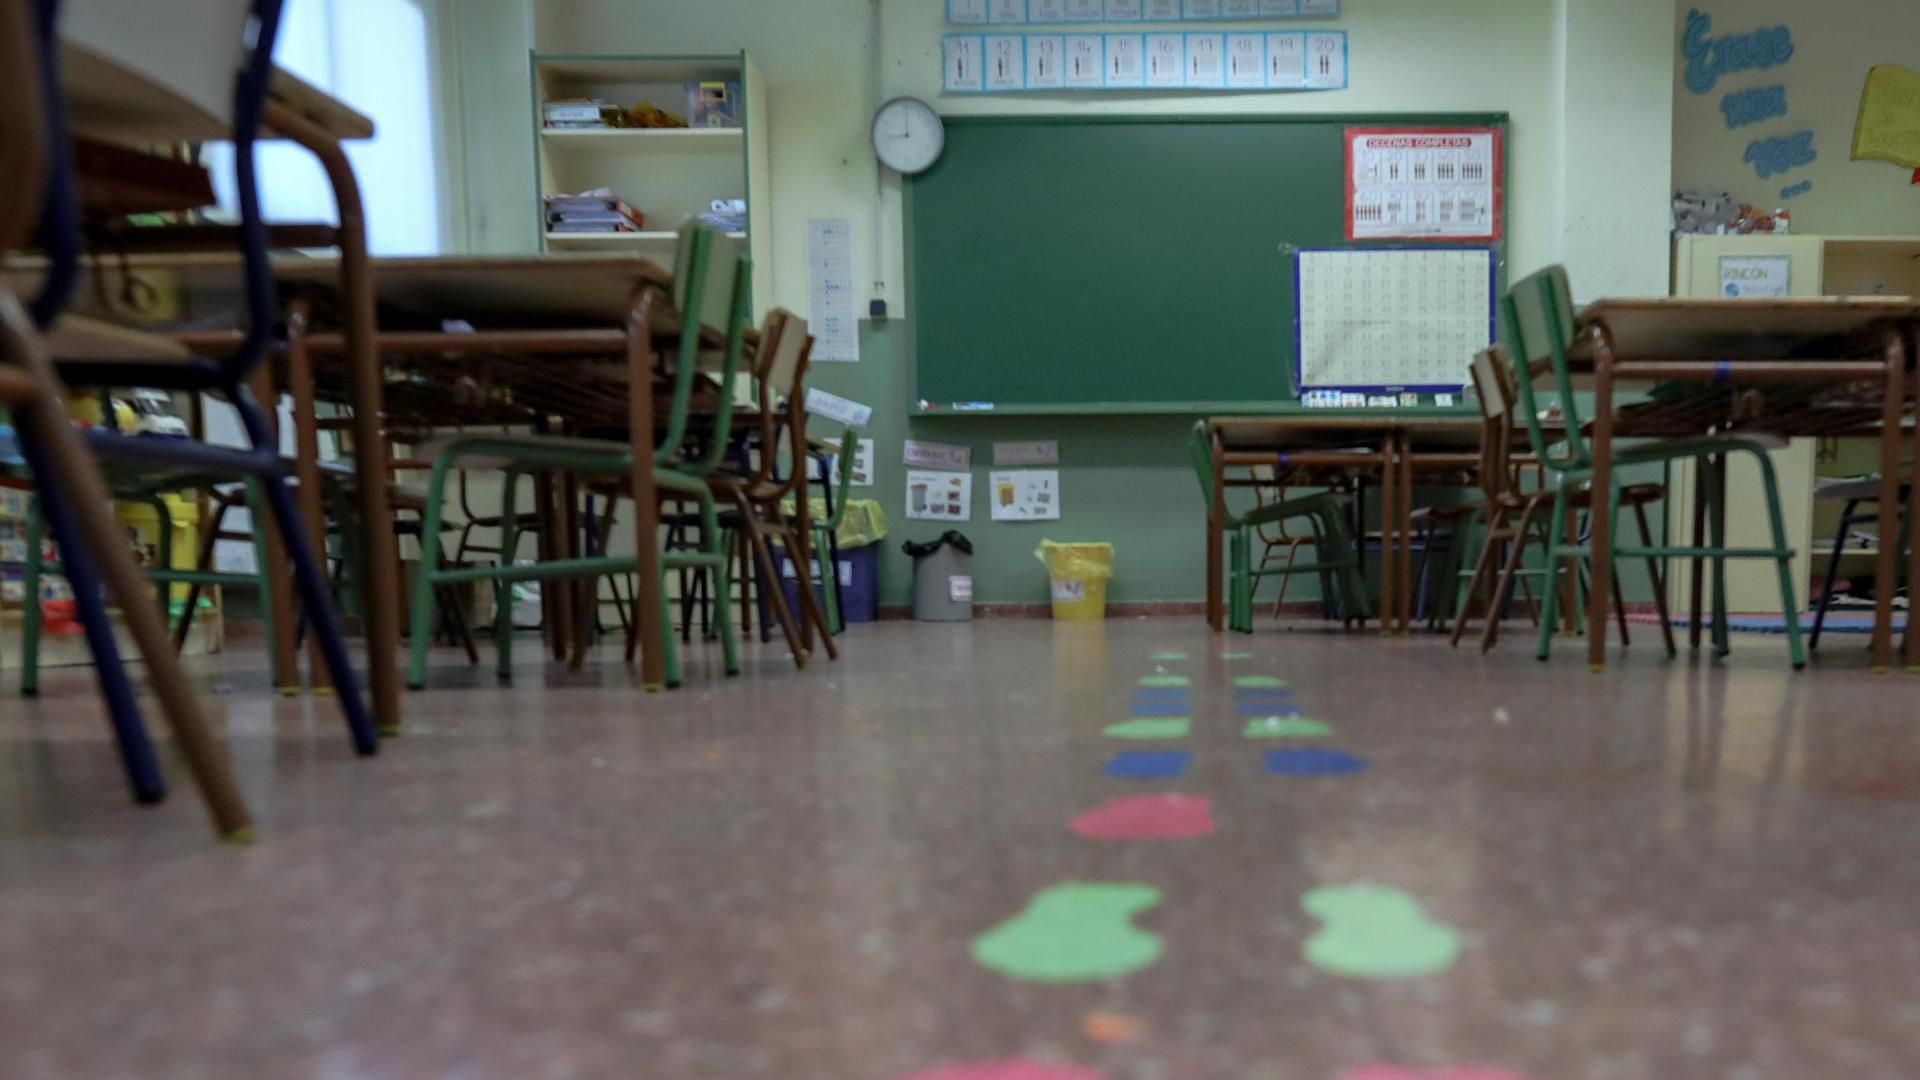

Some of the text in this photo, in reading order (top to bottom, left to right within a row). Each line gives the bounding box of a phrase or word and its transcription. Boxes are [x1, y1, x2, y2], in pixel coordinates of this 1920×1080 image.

[957, 40, 970, 56] 11
[996, 39, 1012, 55] 12
[1039, 39, 1054, 55] 13
[1077, 39, 1091, 53] 14
[1157, 39, 1172, 53] 16
[1199, 39, 1213, 52] 17
[1237, 38, 1252, 53] 18
[1278, 37, 1294, 52] 19
[1316, 38, 1335, 53] 20
[1368, 138, 1469, 148] DECENAS COMPLETAS
[1724, 265, 1769, 280] RINCÓN
